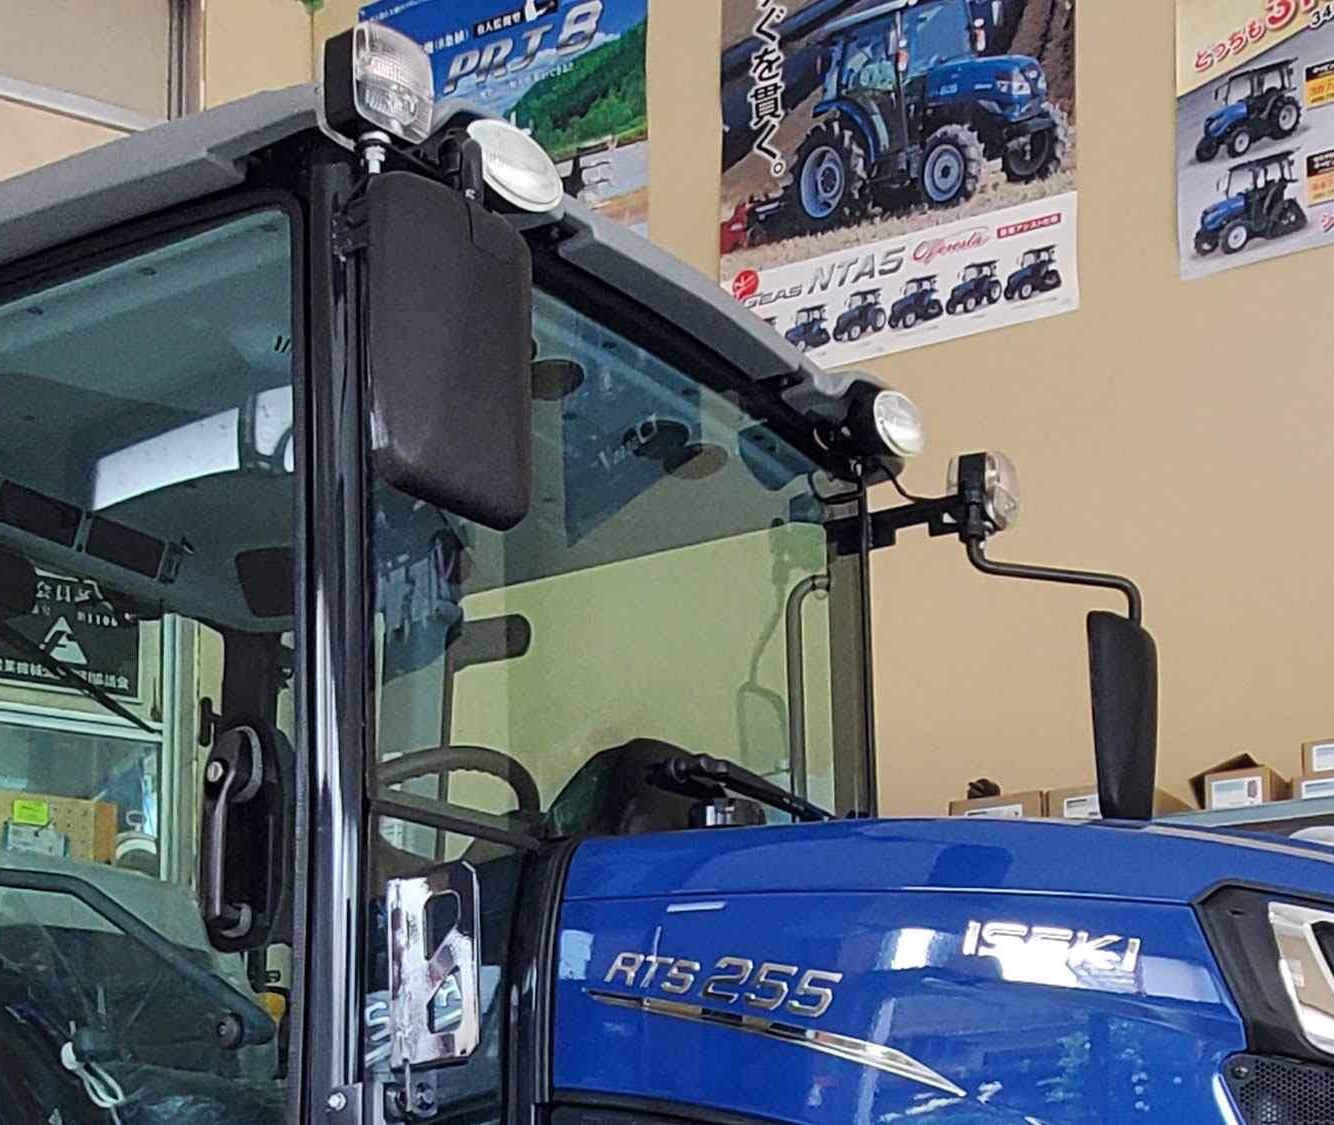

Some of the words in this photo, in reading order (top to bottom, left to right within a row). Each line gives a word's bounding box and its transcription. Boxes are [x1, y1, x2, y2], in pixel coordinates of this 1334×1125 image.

[1194, 21, 1264, 71] どっちも
[750, 0, 785, 175] ぐを貫く。
[963, 919, 1141, 974] ISEKI
[698, 957, 843, 1018] 255
